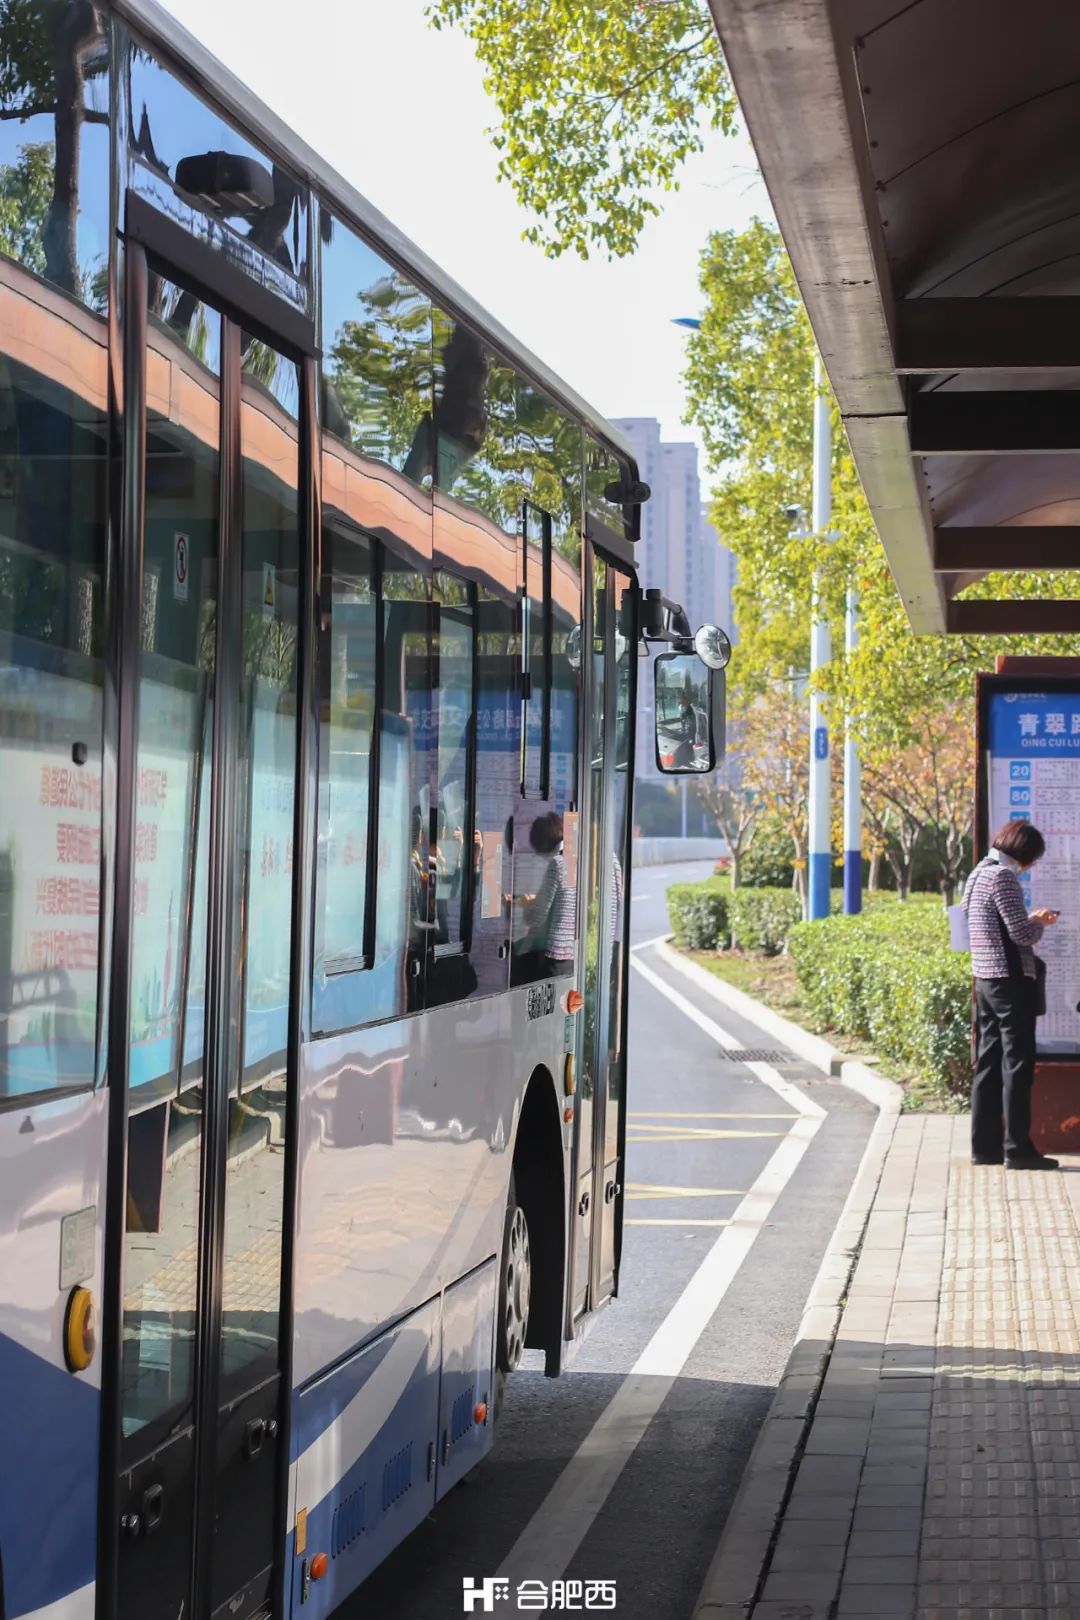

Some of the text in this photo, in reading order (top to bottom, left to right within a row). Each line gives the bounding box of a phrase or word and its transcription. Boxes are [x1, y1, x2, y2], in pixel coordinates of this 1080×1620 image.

[1021, 738, 1047, 747] QING
[1048, 738, 1066, 747] CUI
[1011, 765, 1030, 776] 20
[1011, 790, 1030, 802] 80
